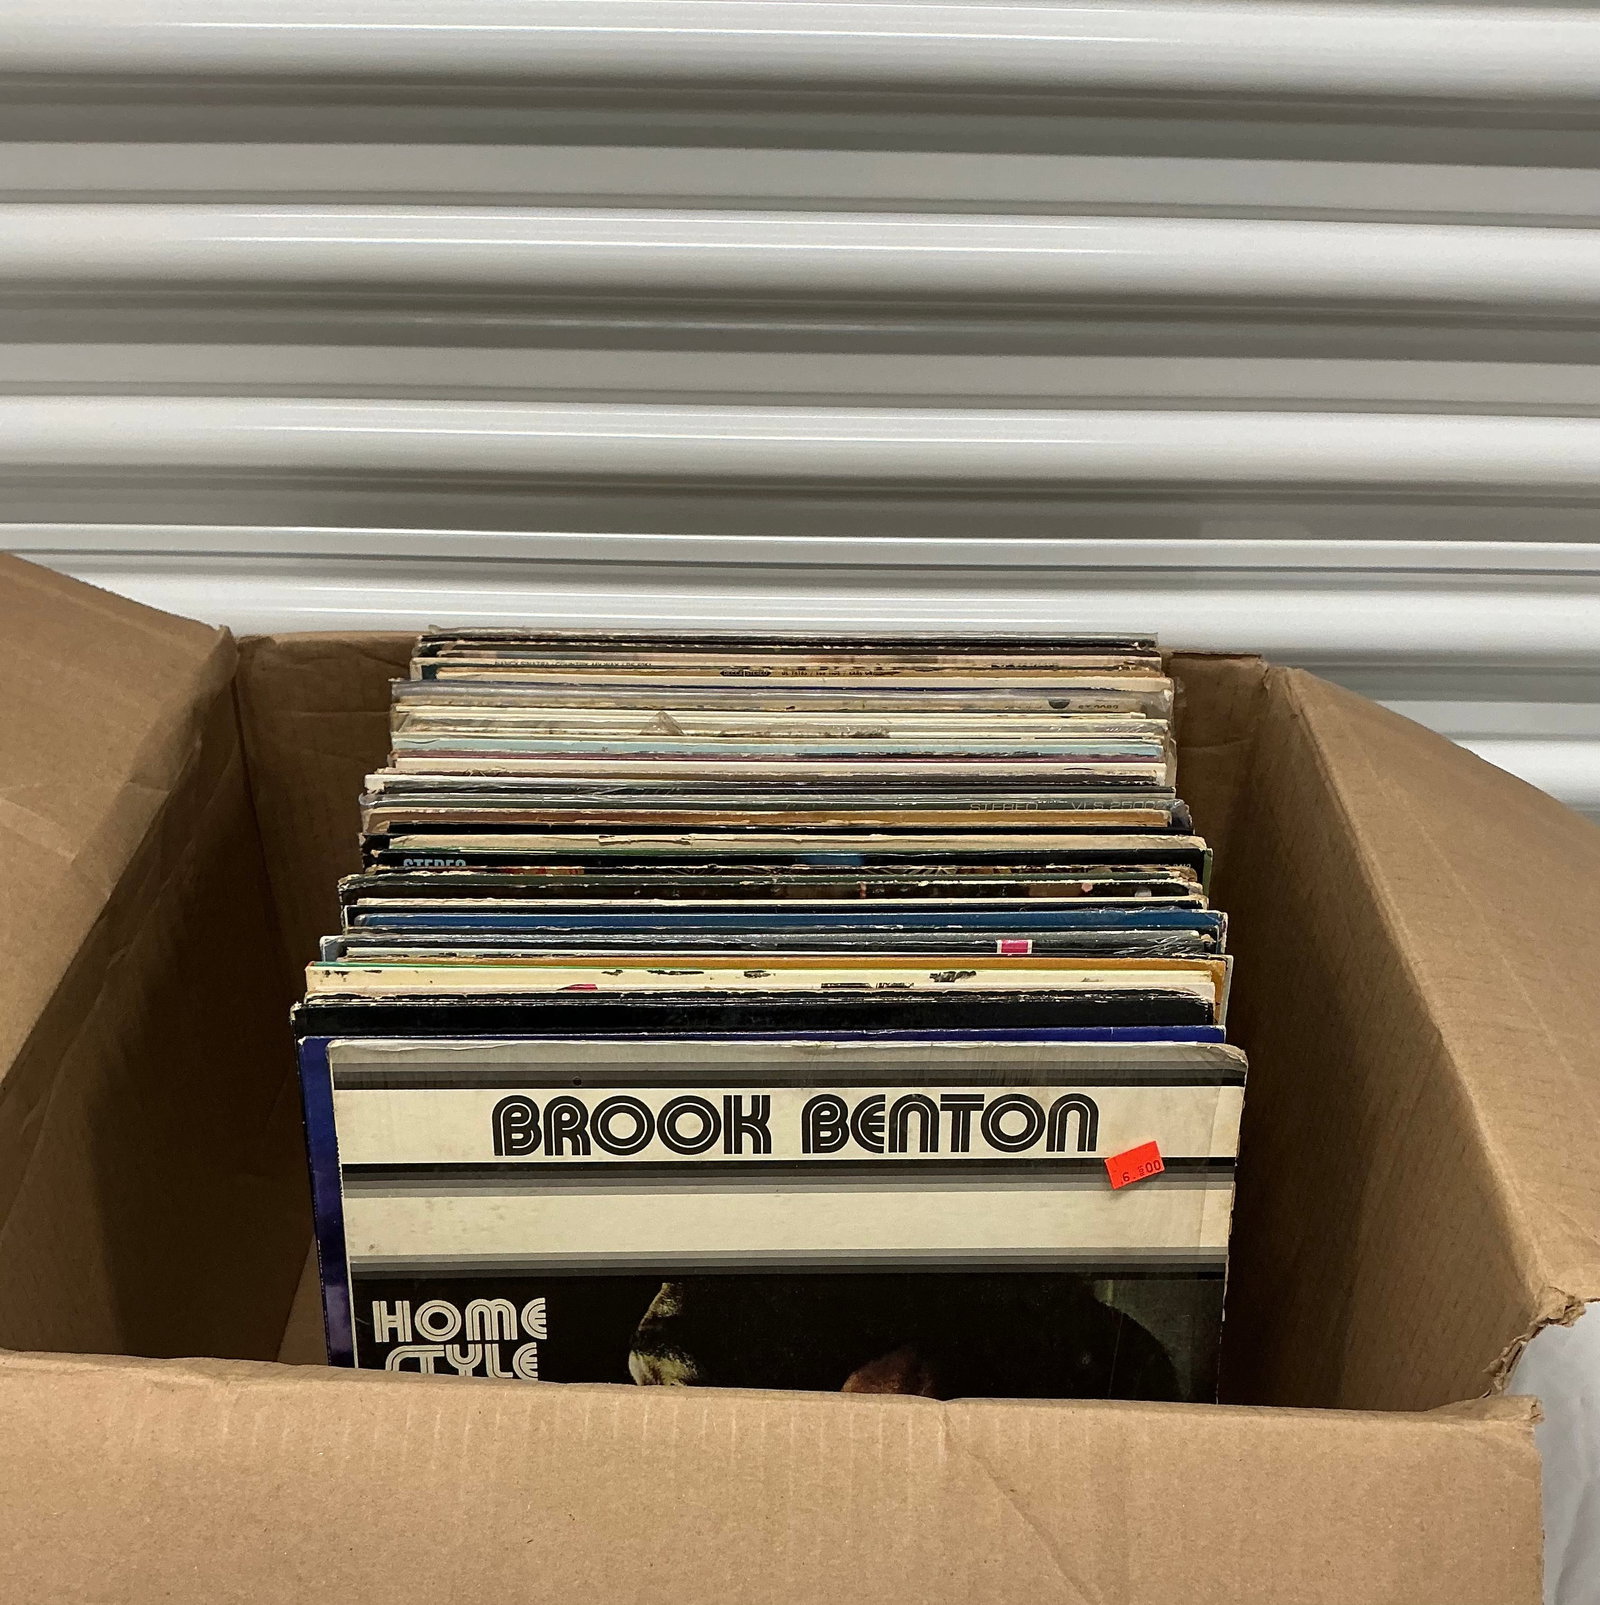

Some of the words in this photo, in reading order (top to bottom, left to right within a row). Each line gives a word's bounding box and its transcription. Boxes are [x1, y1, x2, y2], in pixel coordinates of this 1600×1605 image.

[491, 1094, 773, 1157] BROOK
[801, 1093, 1099, 1154] BENTON
[372, 1297, 548, 1343] HOME
